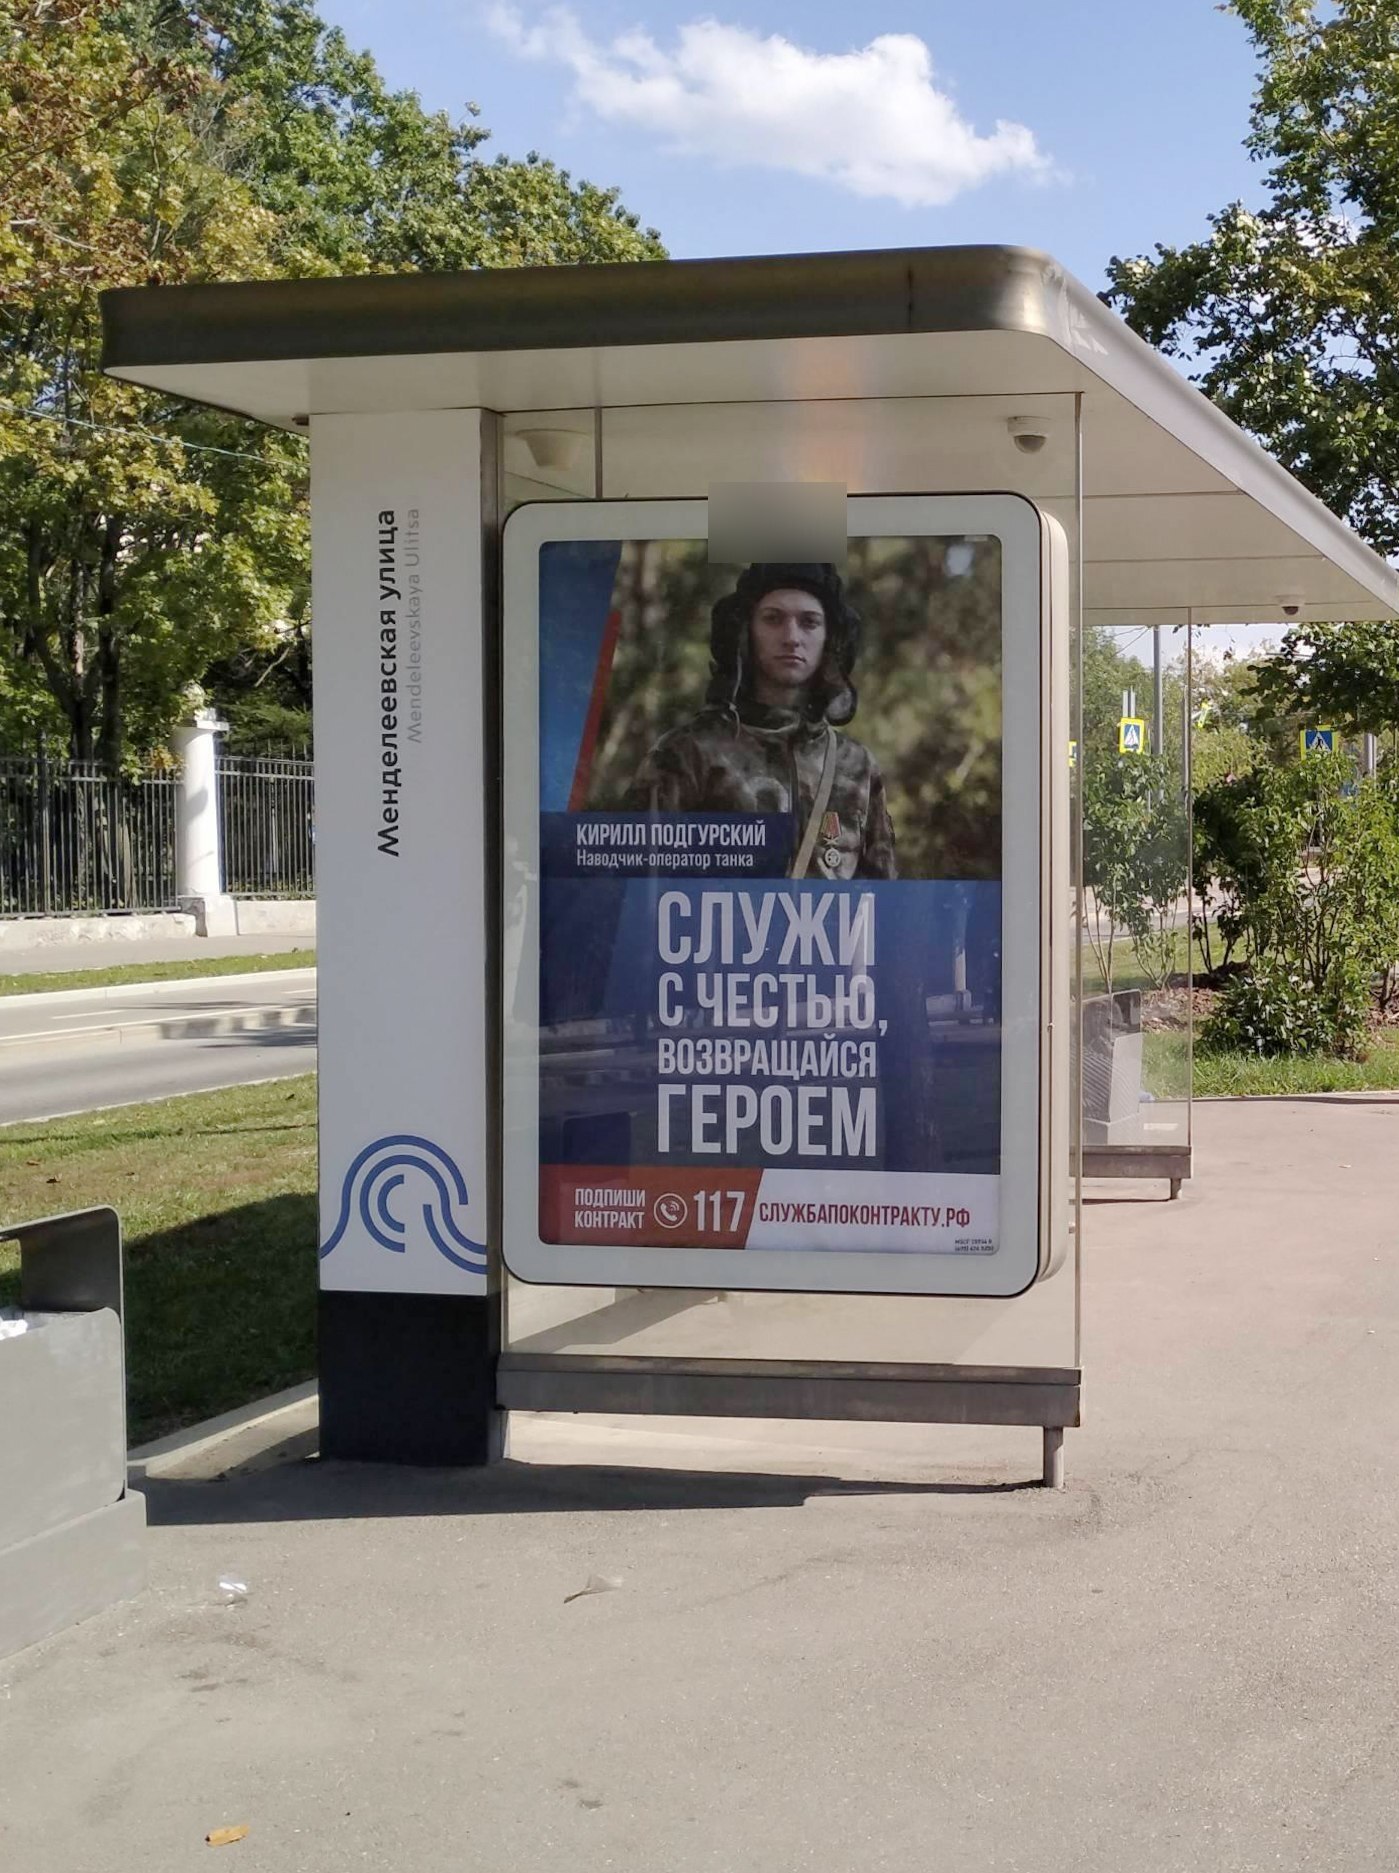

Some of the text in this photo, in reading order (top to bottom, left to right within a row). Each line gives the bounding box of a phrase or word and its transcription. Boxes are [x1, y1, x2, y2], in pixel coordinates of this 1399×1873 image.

[405, 508, 422, 743] Mendeleevskaya Ulitsa
[377, 509, 401, 857] Менделеевская улица
[576, 820, 766, 848] КИРИЛЛ ПОДГУРСКИЙ
[577, 850, 754, 870] Наводчик-оператор танка
[658, 891, 876, 966] СЛУЖИ
[658, 972, 888, 1037] С ЧЕСТЬЮ,
[658, 1033, 877, 1080] ВОЗВРАЩАЙСЯ
[657, 1084, 877, 1157] ГЕРОЕМ
[575, 1188, 646, 1208] ПОДПИШИ
[575, 1211, 645, 1229] КОНТРАКТ
[693, 1190, 745, 1232] 117
[759, 1202, 970, 1228] СЛУЖБАПОКОНТРАКТУ.РФ
